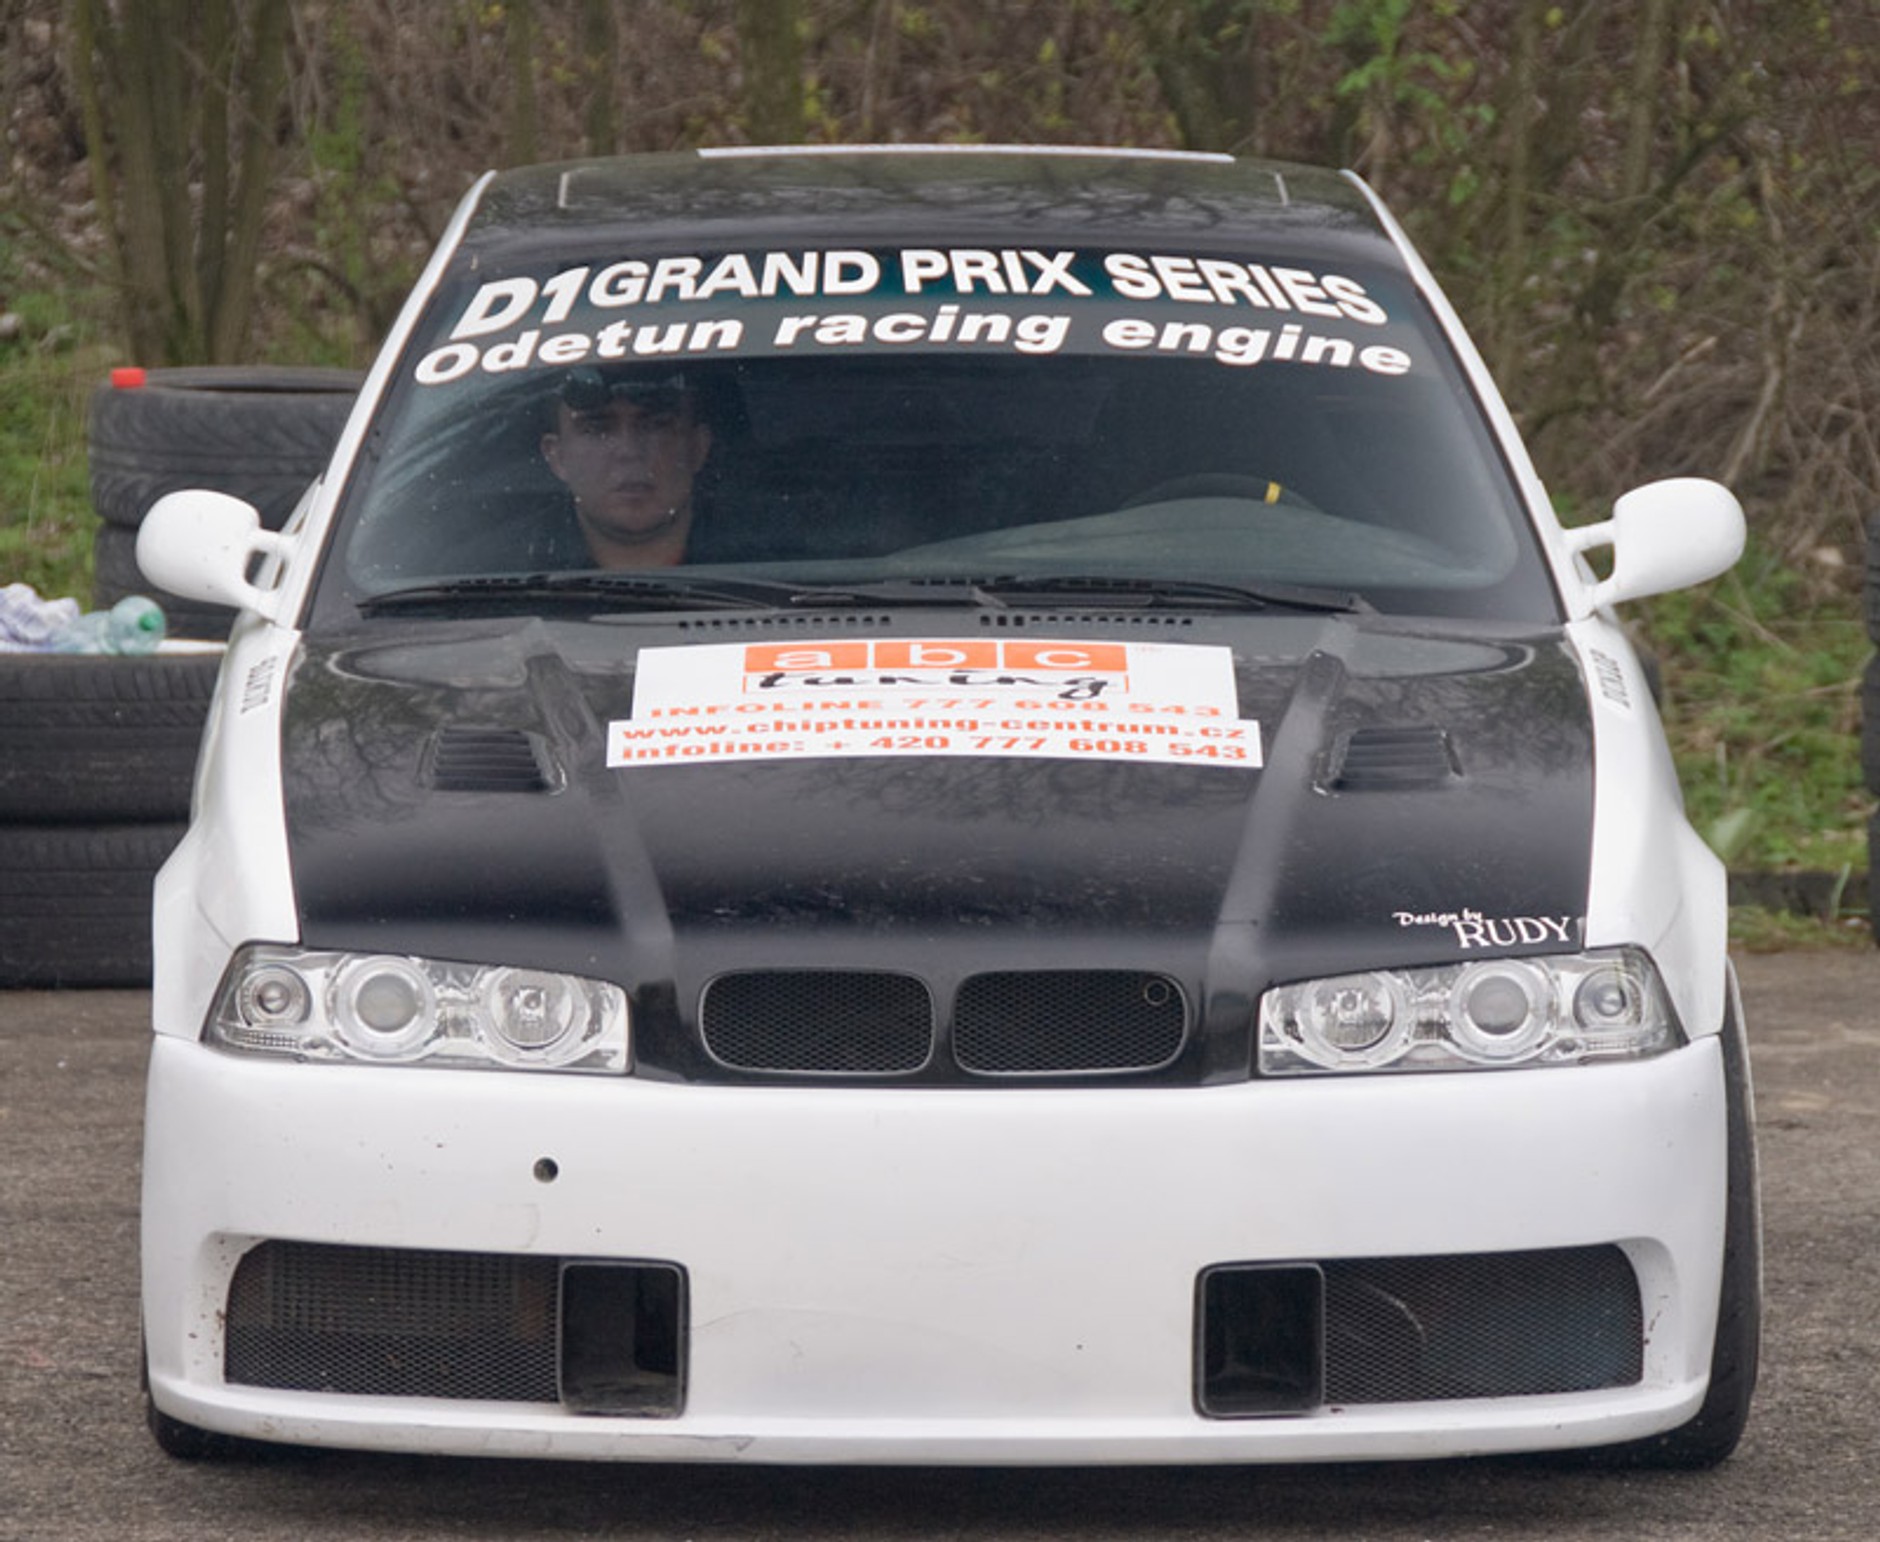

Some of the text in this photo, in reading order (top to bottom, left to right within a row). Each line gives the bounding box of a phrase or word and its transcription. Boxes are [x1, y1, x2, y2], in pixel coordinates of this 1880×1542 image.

[900, 249, 1093, 295] PRIX
[1103, 253, 1388, 326] SERIES
[414, 305, 1412, 386] Odetun racing engine
[759, 669, 1108, 699] tuning
[651, 698, 882, 718] INFOLINE
[902, 698, 996, 712] 777
[1128, 702, 1221, 717] 543
[622, 717, 1246, 740] www.chiptuning-centrum.cz
[622, 741, 804, 760] infoline:
[870, 735, 950, 750] 420
[969, 736, 1048, 750] 777
[1069, 738, 1148, 754] 608
[1169, 742, 1247, 760] 543
[1392, 907, 1482, 927] Design by
[1453, 916, 1570, 949] RUDY
